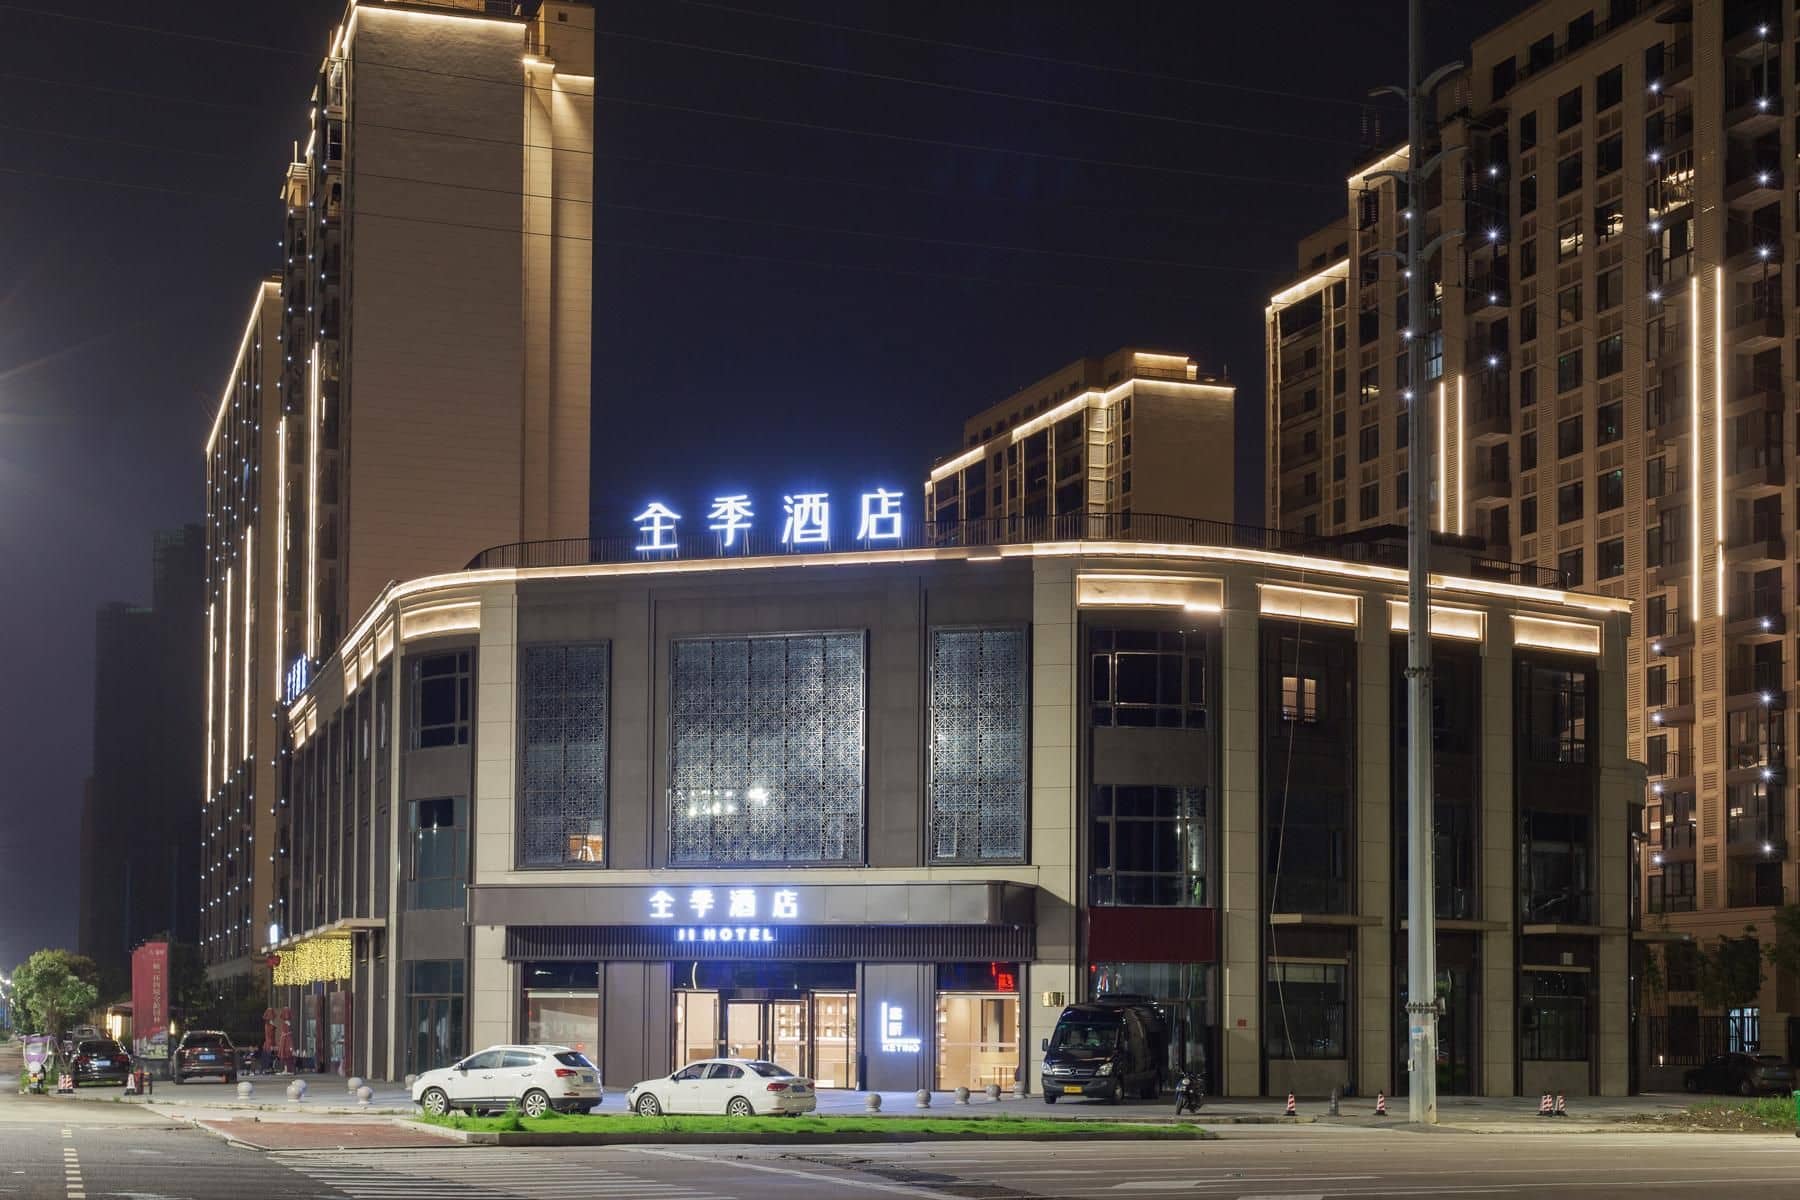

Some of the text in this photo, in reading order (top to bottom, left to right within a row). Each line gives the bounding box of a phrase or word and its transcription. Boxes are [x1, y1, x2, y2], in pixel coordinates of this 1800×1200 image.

[633, 488, 904, 550] 全季酒店
[648, 889, 798, 918] 全季酒店
[703, 928, 774, 941] HOTEL
